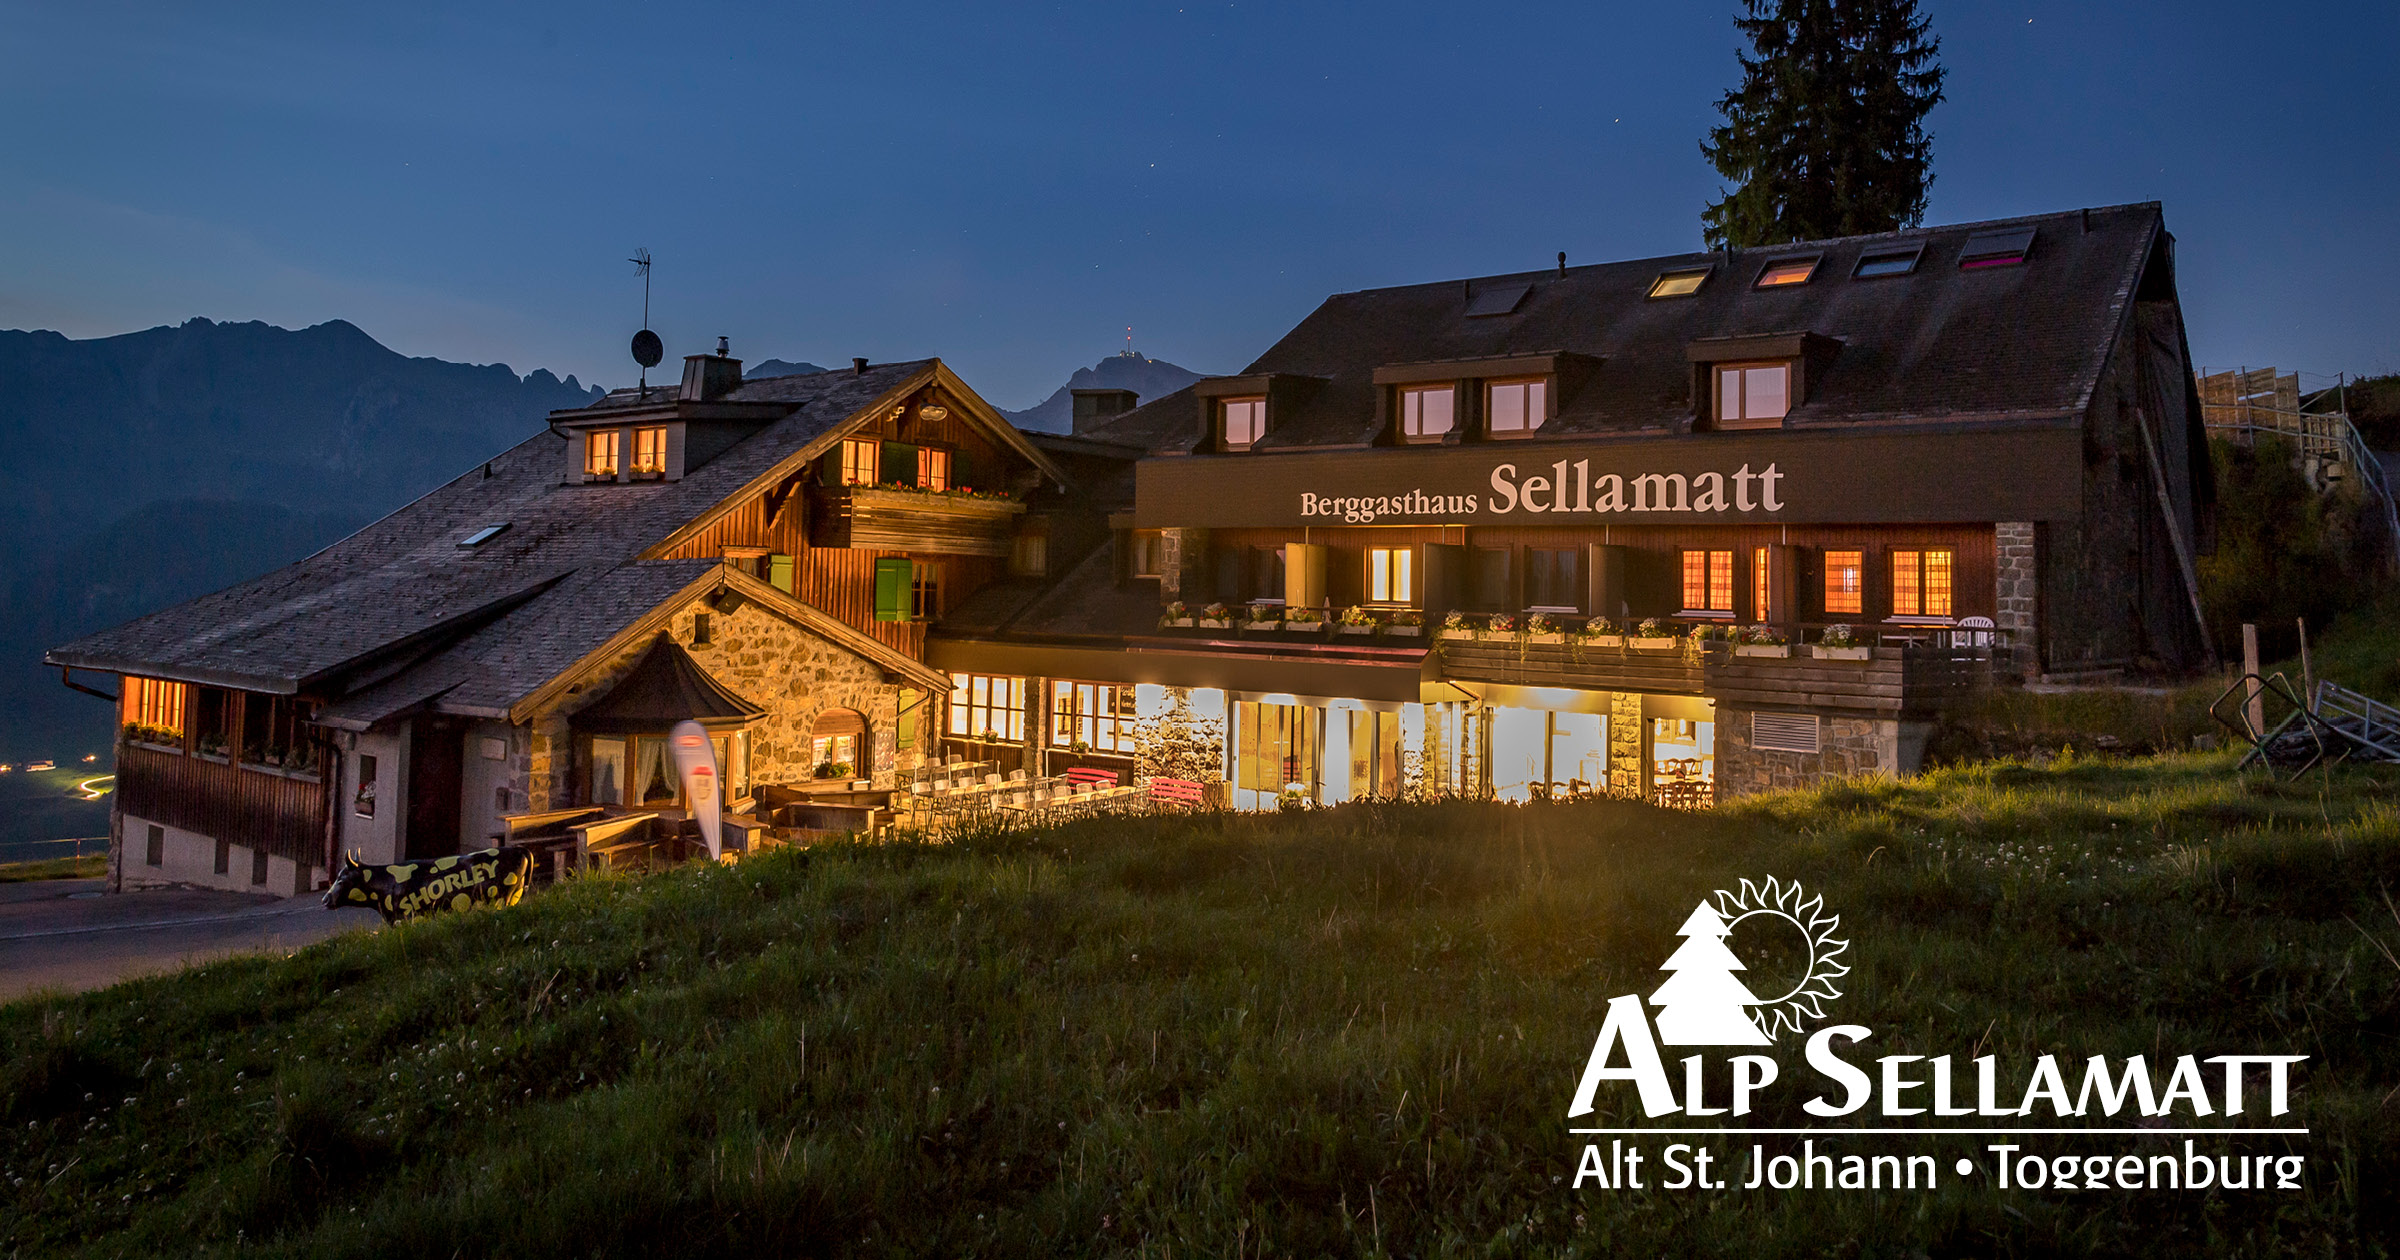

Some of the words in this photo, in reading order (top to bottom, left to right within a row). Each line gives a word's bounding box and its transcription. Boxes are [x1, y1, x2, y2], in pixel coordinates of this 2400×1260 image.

[1300, 488, 1478, 523] Berggasthaus
[1489, 458, 1786, 514] Sellamatt
[399, 859, 500, 916] SHORLEY
